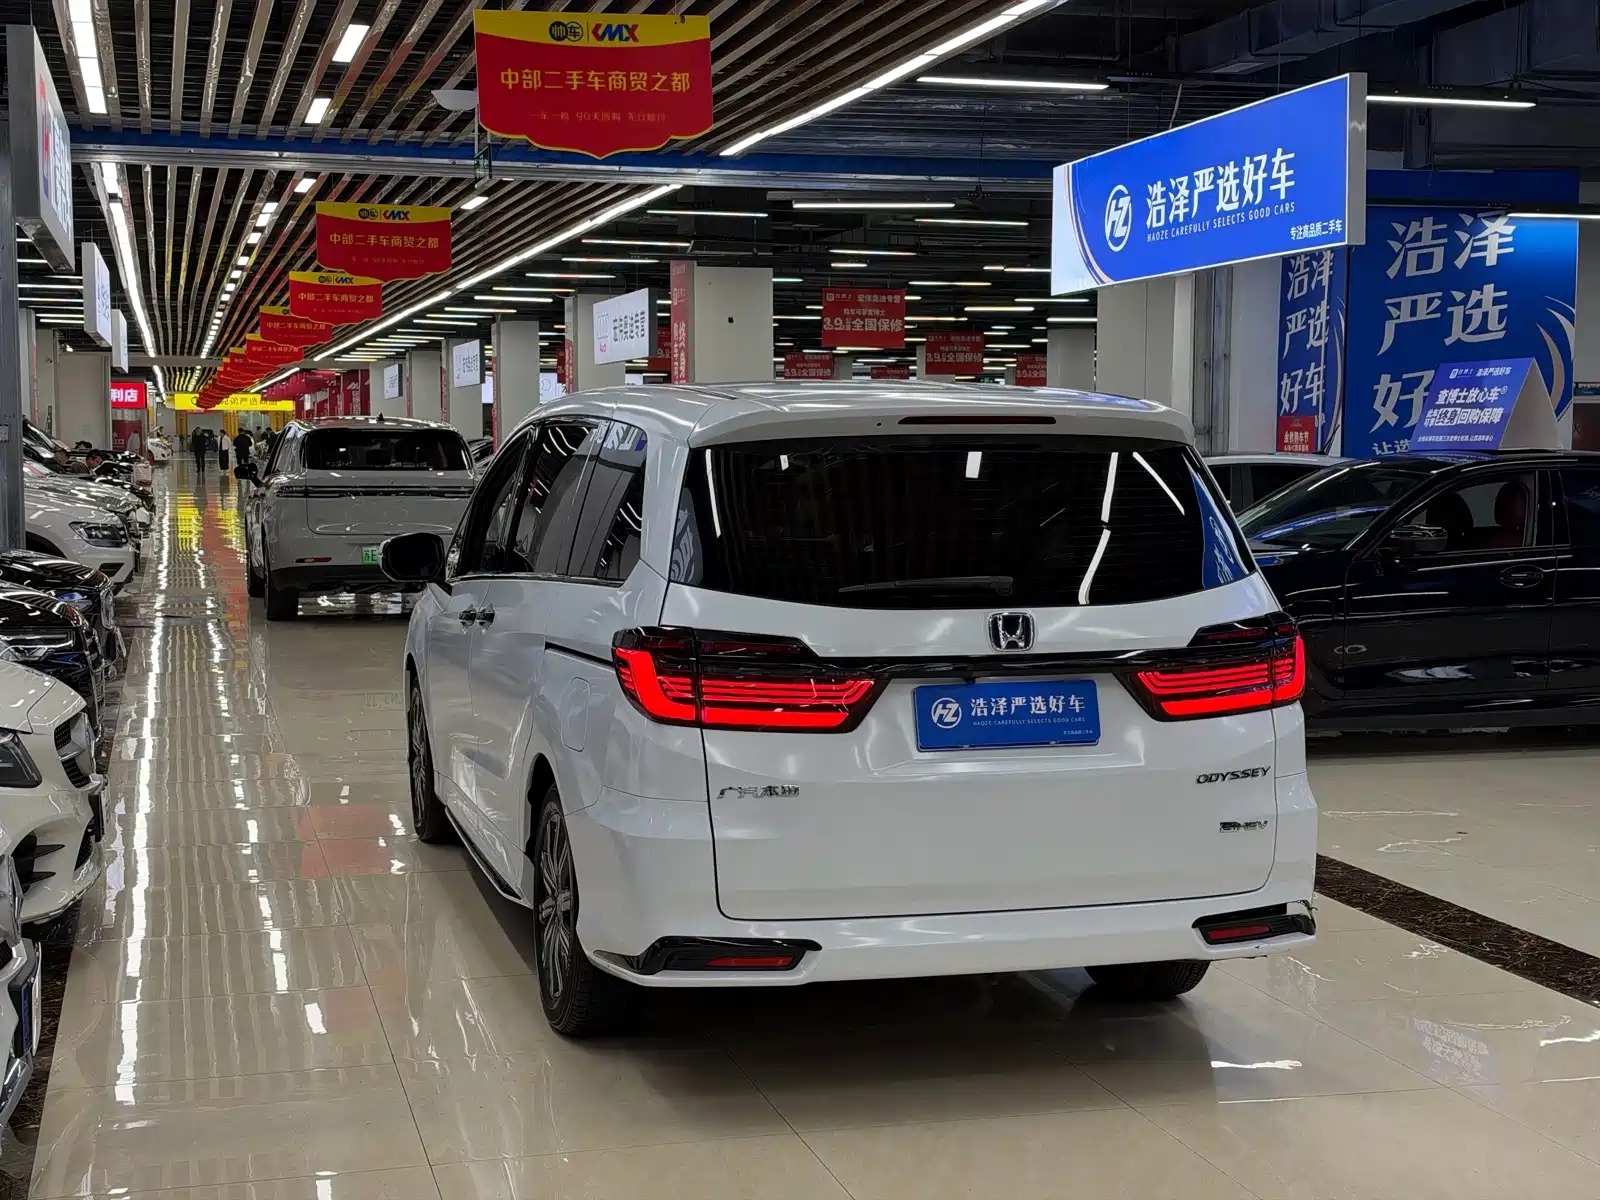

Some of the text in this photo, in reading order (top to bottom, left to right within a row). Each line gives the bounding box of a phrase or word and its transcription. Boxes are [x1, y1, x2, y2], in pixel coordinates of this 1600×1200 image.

[501, 68, 690, 92] 中部二手车商贸之都
[1146, 147, 1296, 229] 浩泽严选好车
[330, 232, 439, 249] 中部二手车商贸之都
[1147, 201, 1295, 242] HAOZE CAREFULLY SELECTS GOOD CARS
[1290, 219, 1342, 240] 专注高品质二手车
[1386, 210, 1516, 279] 浩泽
[1282, 301, 1330, 359] 严选
[1377, 284, 1508, 356] 严选
[1280, 362, 1327, 416] 好车
[971, 694, 1085, 717] 浩泽严选好车
[1196, 765, 1271, 784] ODYSSEY
